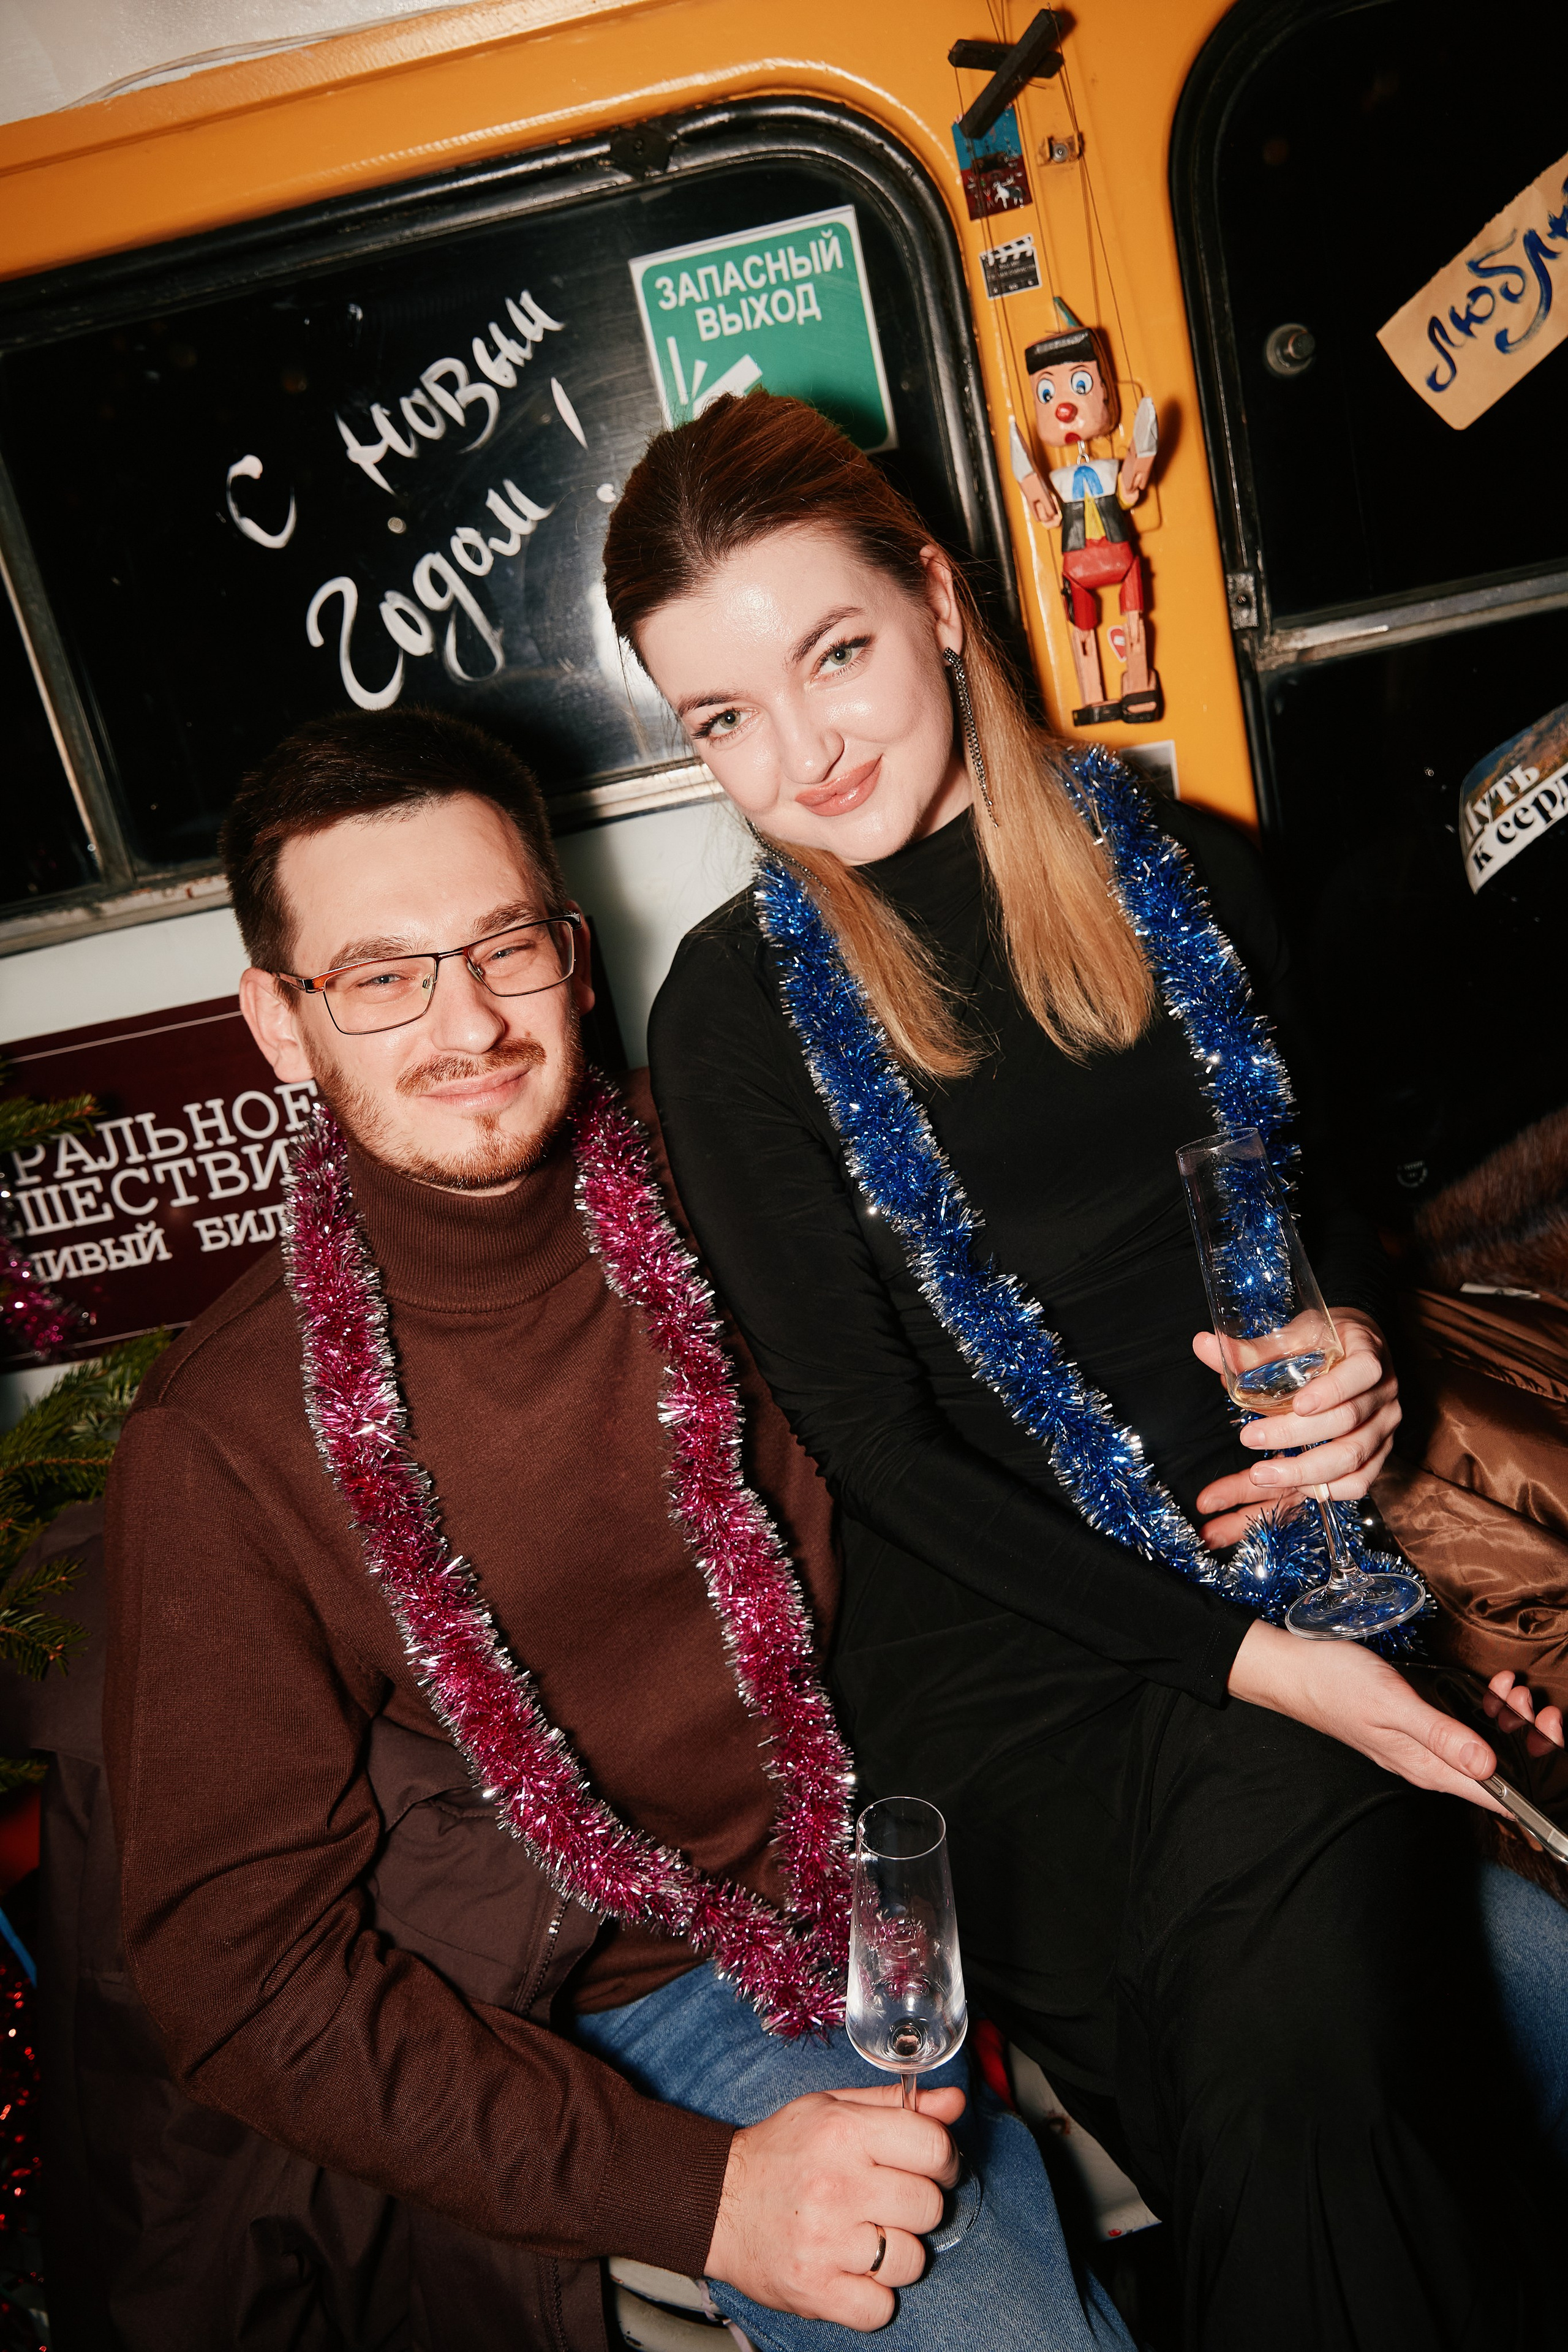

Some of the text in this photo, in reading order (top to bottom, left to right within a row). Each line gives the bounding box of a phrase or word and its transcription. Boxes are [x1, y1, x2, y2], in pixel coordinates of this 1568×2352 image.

[654, 228, 844, 311] ЗАПАСНЫЙ
[695, 282, 822, 342] ВЫХОД
[9, 1137, 300, 1238] ШЕСТВИ
